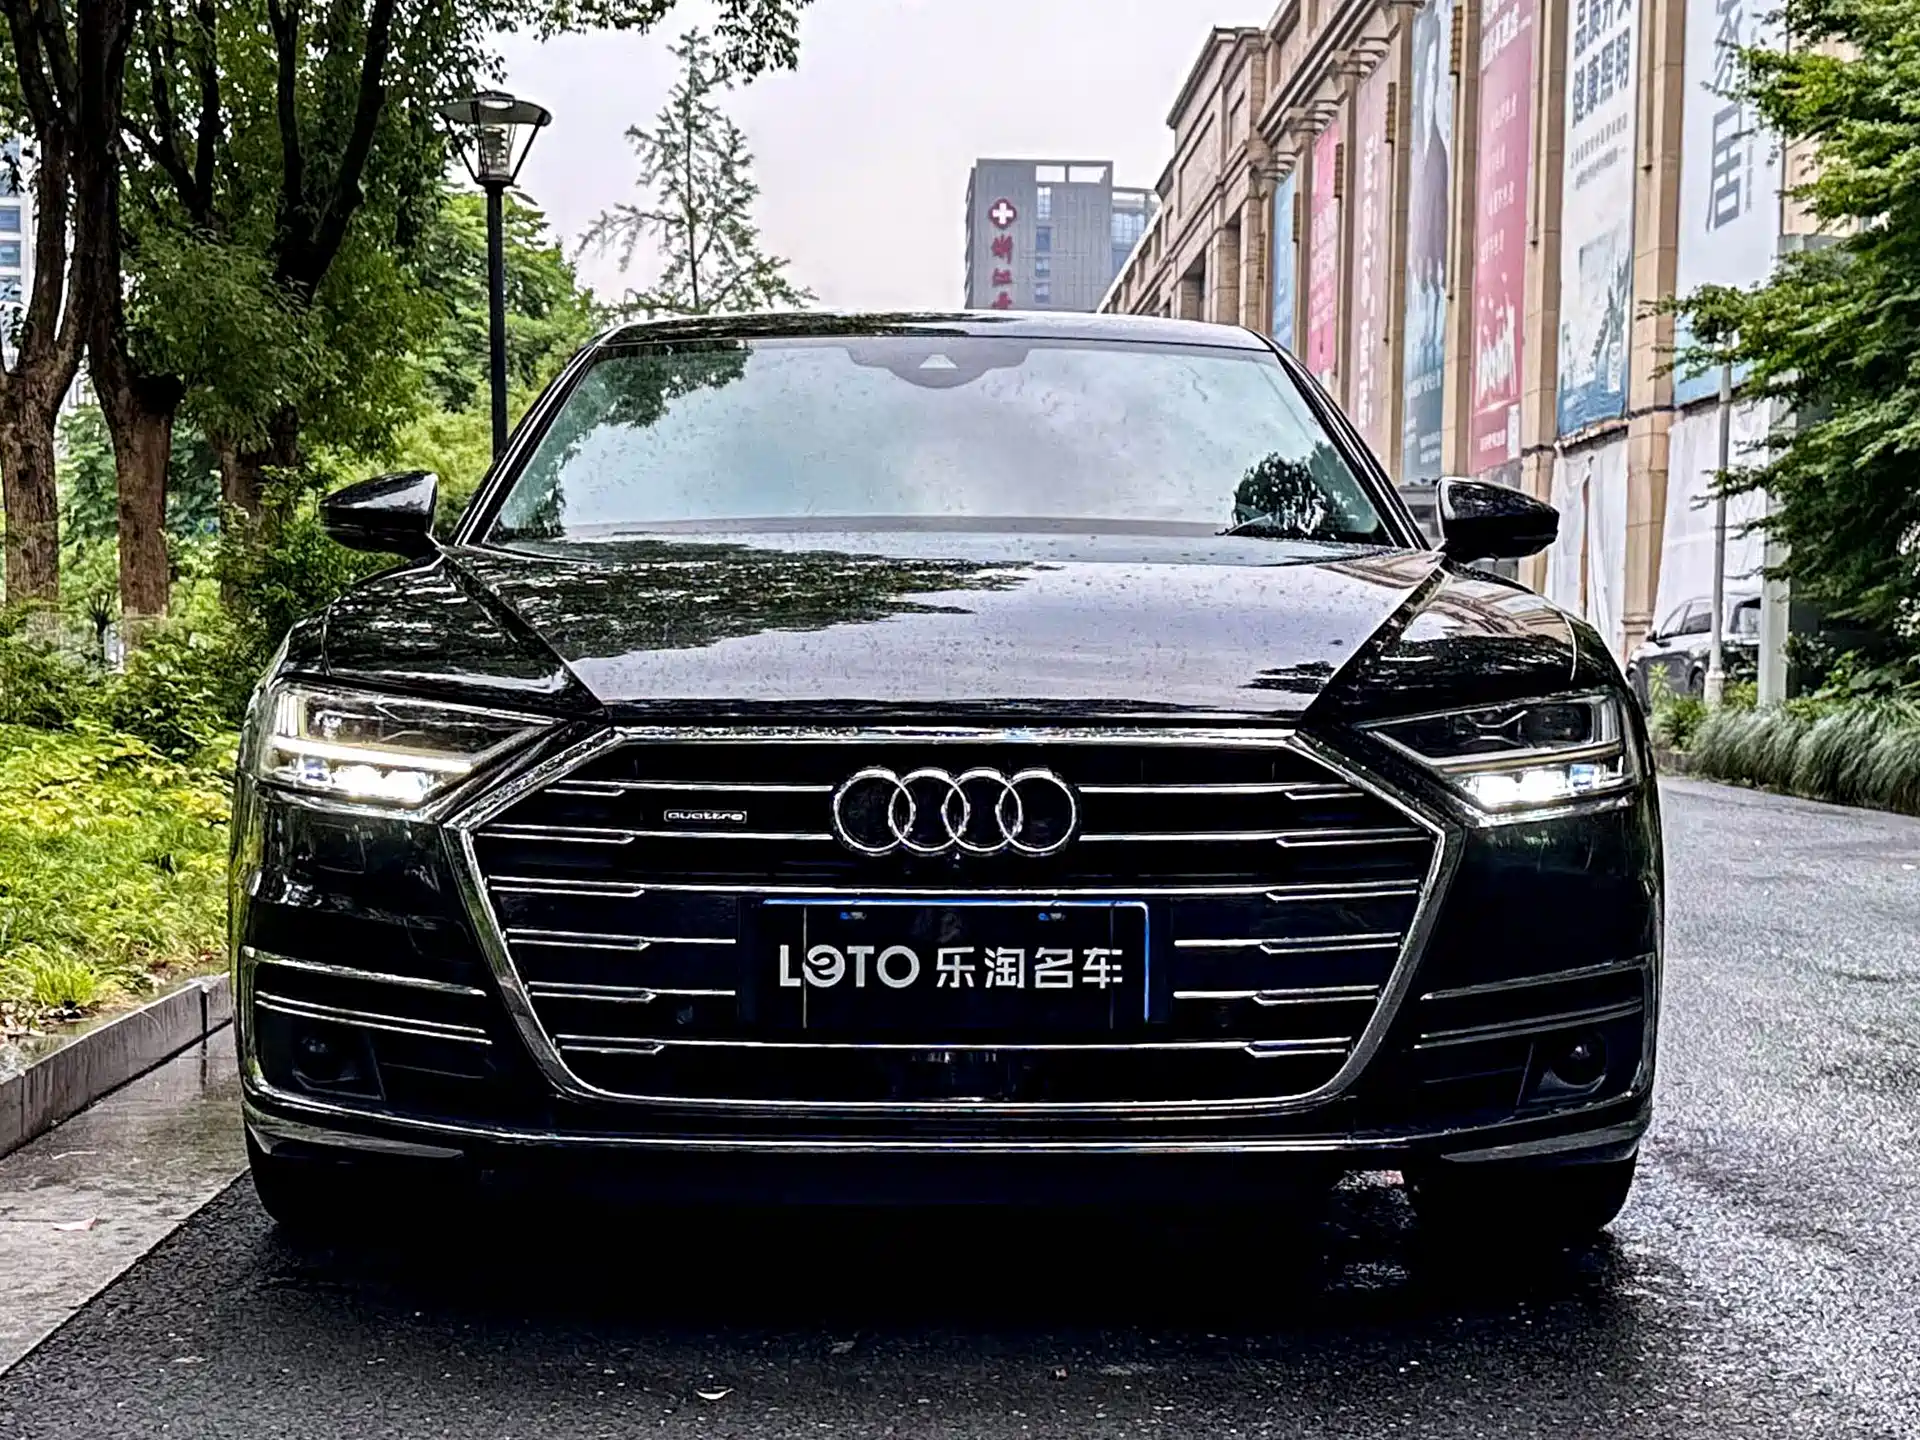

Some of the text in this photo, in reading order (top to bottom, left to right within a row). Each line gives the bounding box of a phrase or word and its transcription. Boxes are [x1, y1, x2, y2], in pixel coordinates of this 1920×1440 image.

[667, 811, 744, 821] quattro
[779, 944, 1123, 989] LOTO 乐淘名车
